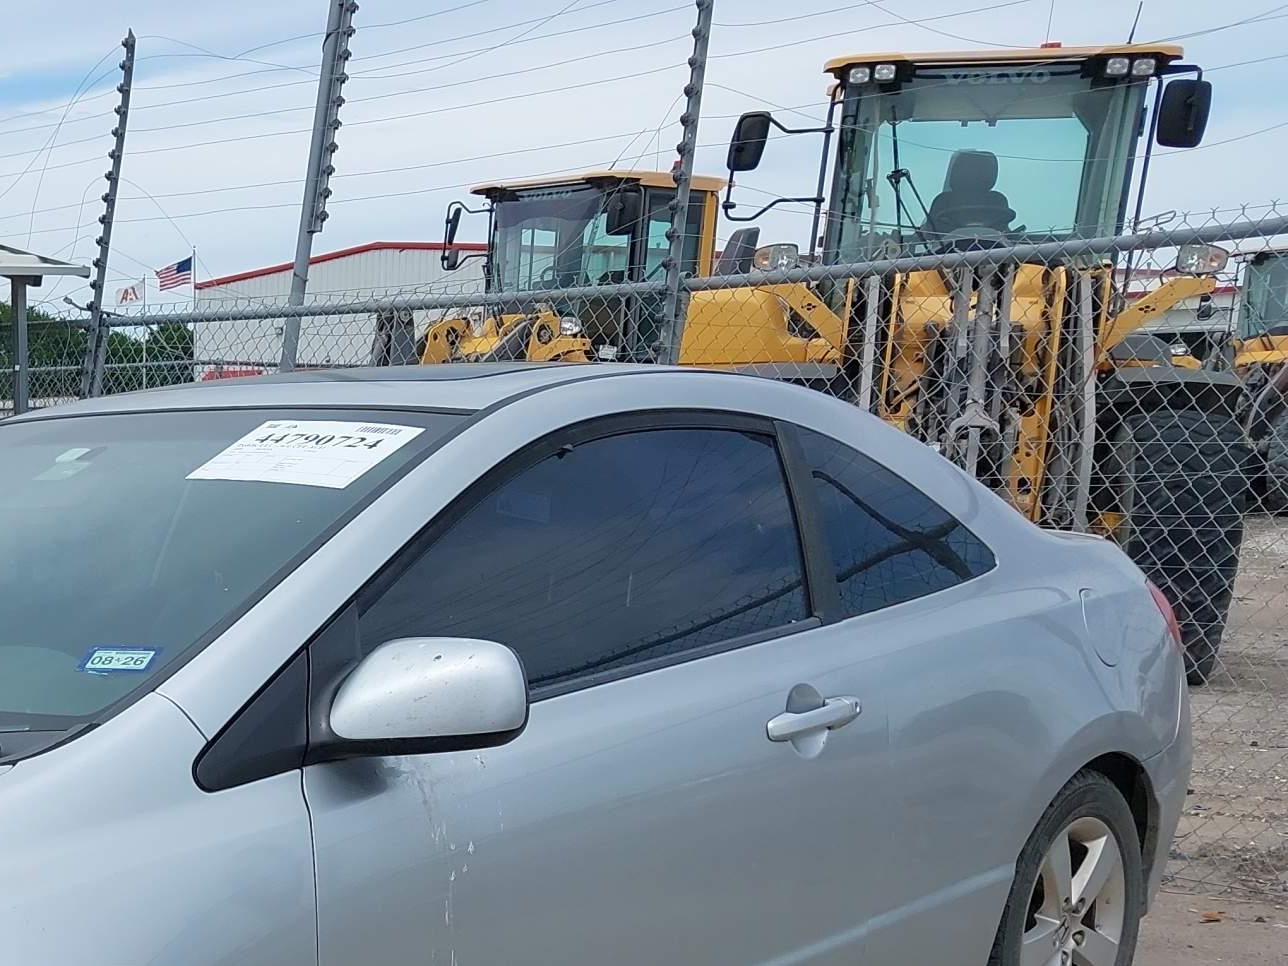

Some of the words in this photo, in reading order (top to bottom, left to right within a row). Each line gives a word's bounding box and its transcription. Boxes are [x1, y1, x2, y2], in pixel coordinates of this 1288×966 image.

[942, 69, 1051, 85] VOLVO
[254, 432, 385, 450] 44790724
[90, 655, 114, 666] 08
[119, 656, 147, 666] 26
